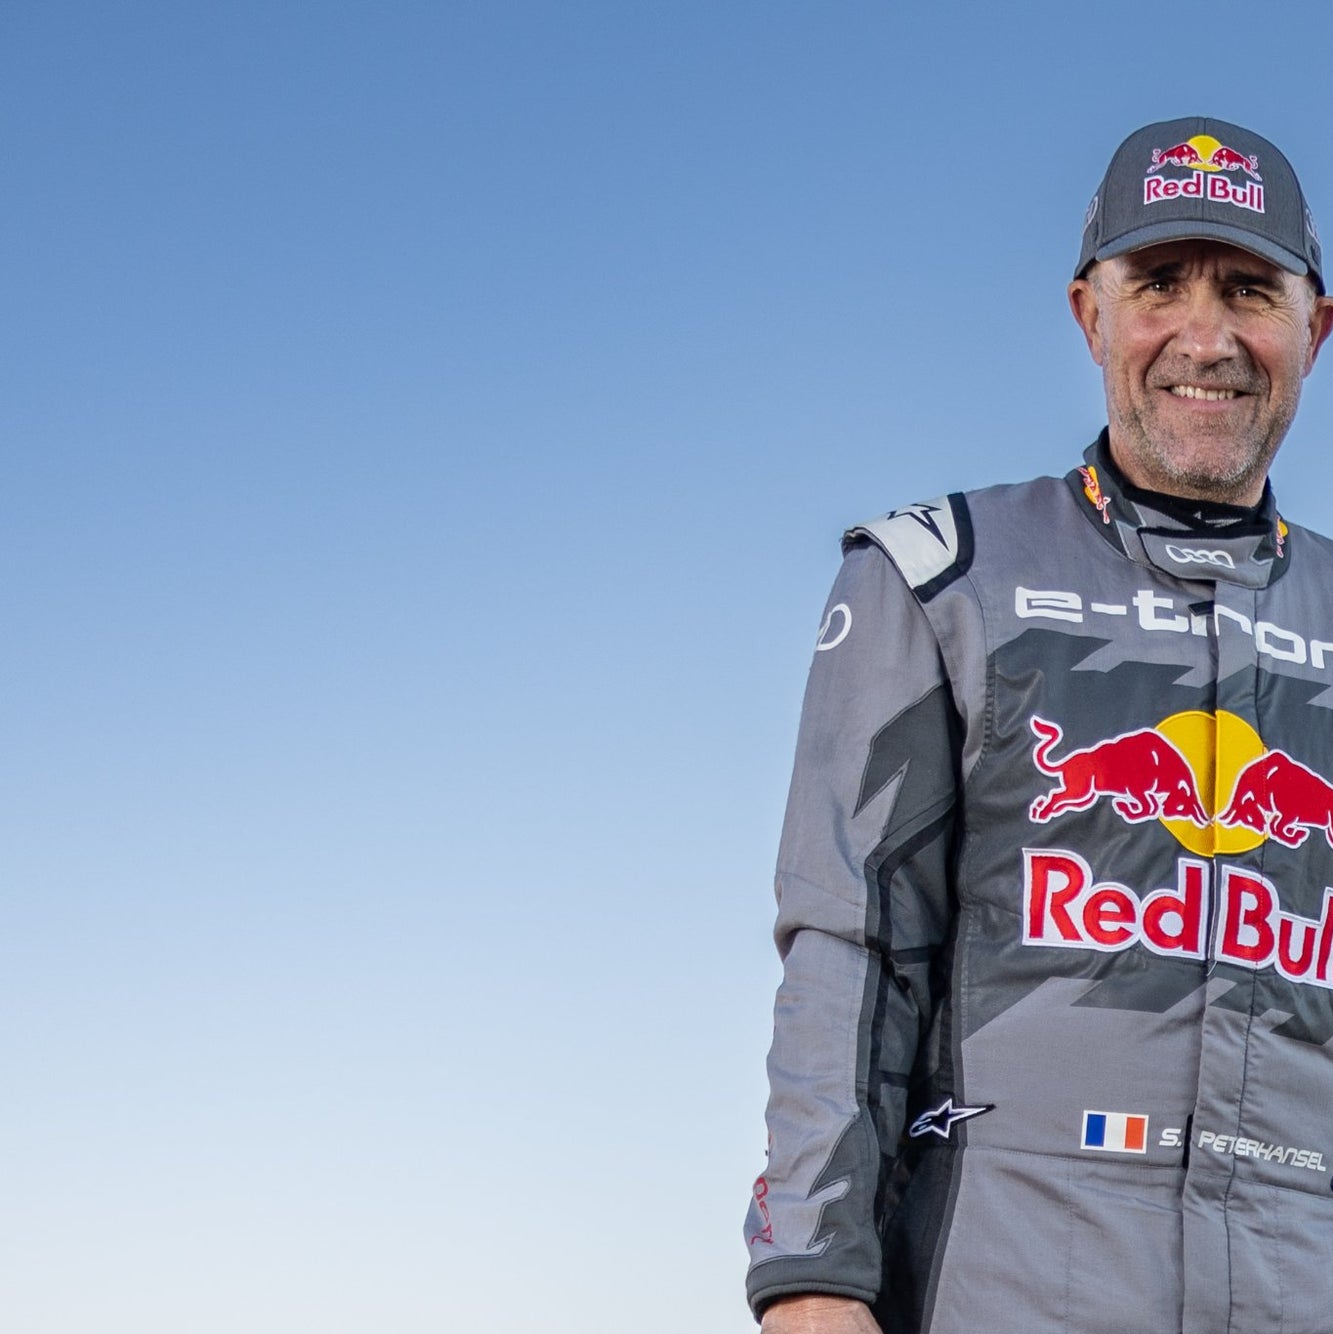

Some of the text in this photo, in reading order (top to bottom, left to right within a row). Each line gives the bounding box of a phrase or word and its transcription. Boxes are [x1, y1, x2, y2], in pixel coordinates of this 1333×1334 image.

[1144, 172, 1265, 214] Red Bull
[1022, 848, 1210, 960] Red
[1159, 1128, 1327, 1172] S. PETERHANSEL
